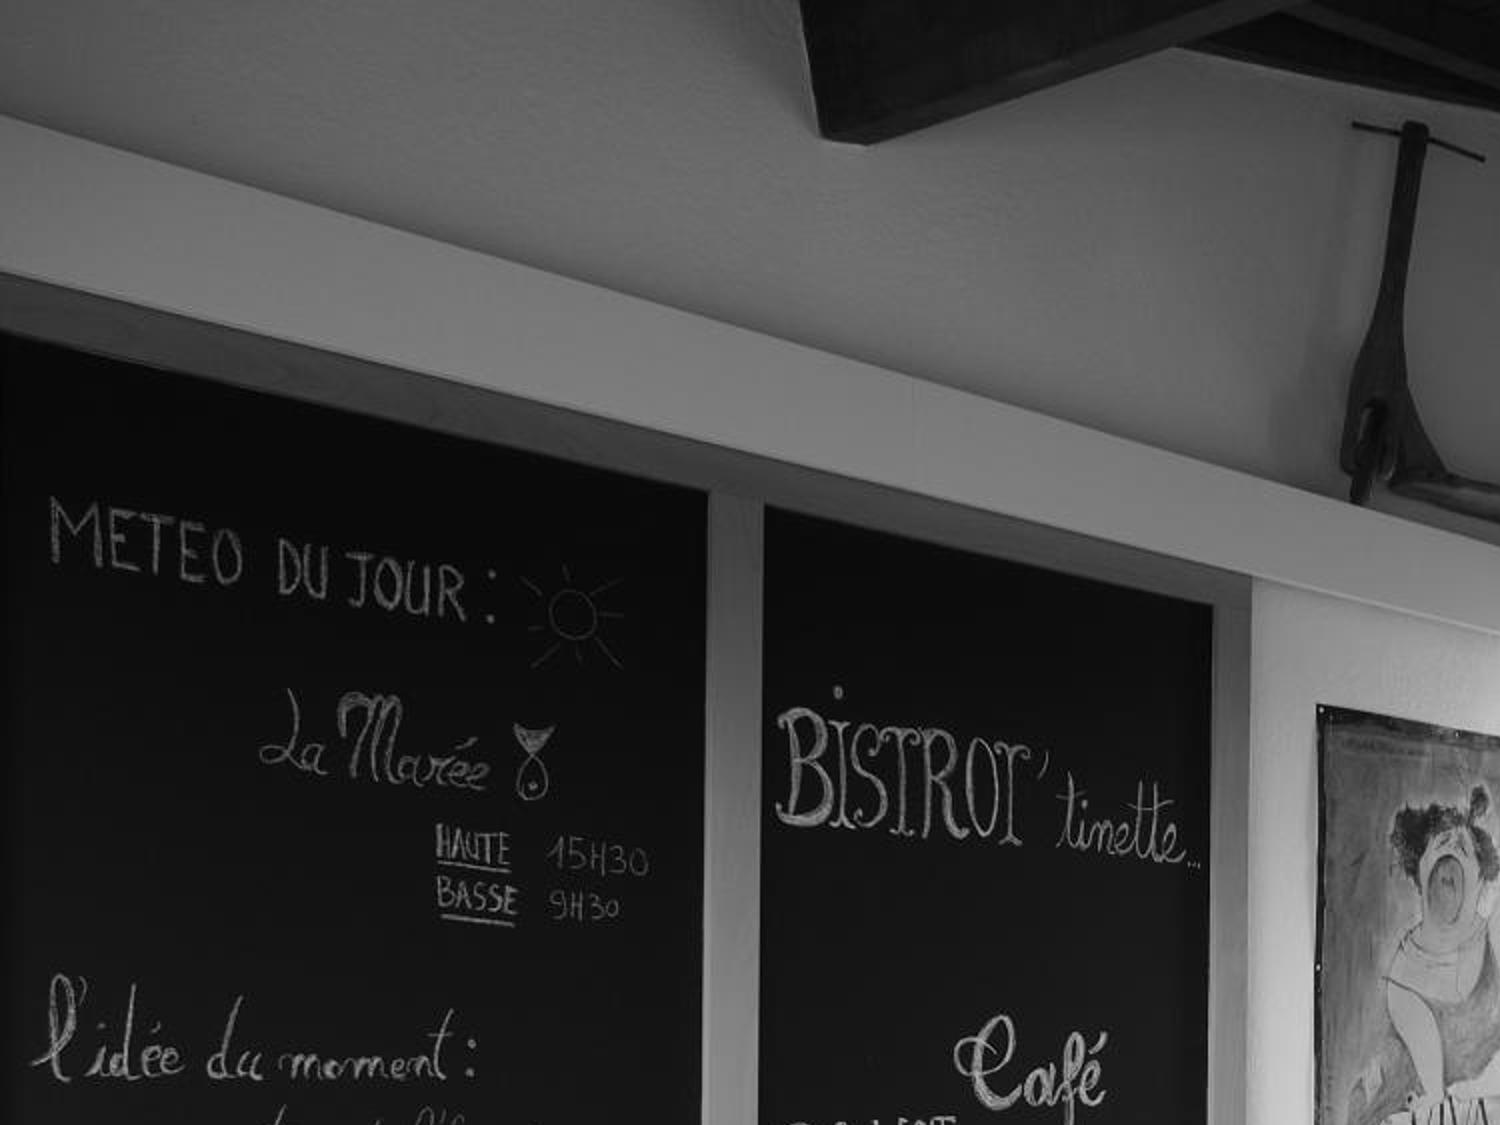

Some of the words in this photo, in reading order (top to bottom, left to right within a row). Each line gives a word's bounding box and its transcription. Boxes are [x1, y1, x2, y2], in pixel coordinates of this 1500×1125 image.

[50, 496, 243, 586] METEO
[278, 536, 329, 599] DU
[258, 687, 328, 777] La
[336, 690, 492, 792] Marée
[435, 822, 512, 866] HAUTE
[545, 835, 650, 878] 15H30
[436, 875, 520, 917] BASSE
[206, 996, 264, 1081] du
